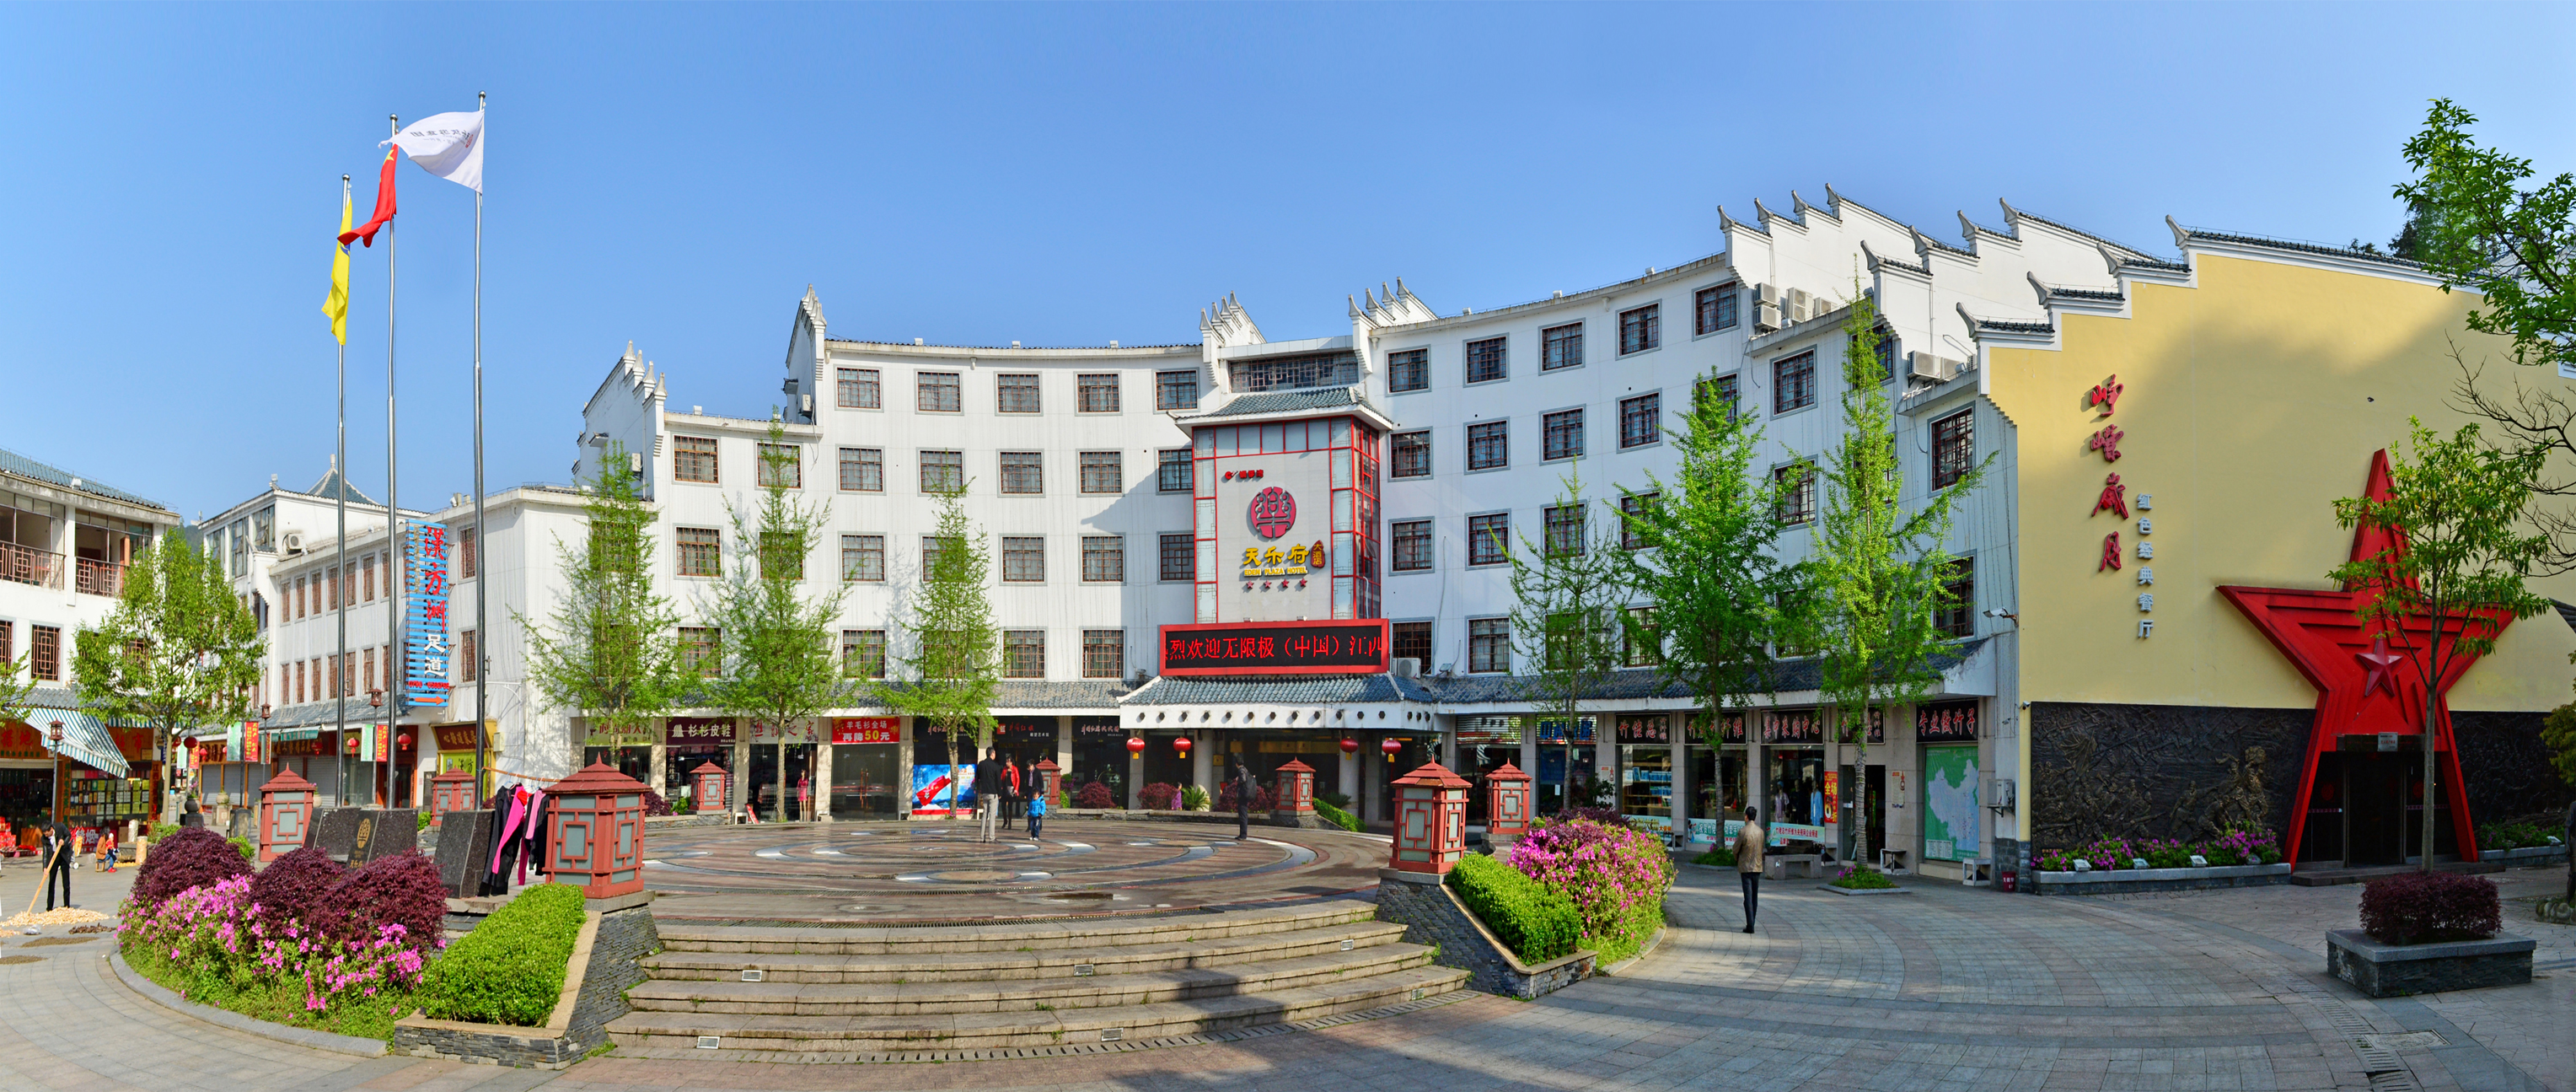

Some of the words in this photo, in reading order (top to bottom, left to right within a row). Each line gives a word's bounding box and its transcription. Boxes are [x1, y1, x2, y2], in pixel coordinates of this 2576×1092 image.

[1242, 543, 1310, 567] 天乐府
[1312, 543, 1323, 566] 大酒店
[1244, 568, 1261, 577] EDEN
[1264, 568, 1285, 576] PLAZA
[1287, 566, 1307, 575] HOTEL
[2137, 493, 2155, 639] 红色经典餐厅
[688, 724, 732, 737] 杉杉皮鞋
[846, 720, 888, 729] 羊毛衫全场
[1540, 720, 1592, 740] 中通递
[1763, 714, 1821, 740] 集中采购中心
[843, 730, 890, 742] 再降50元
